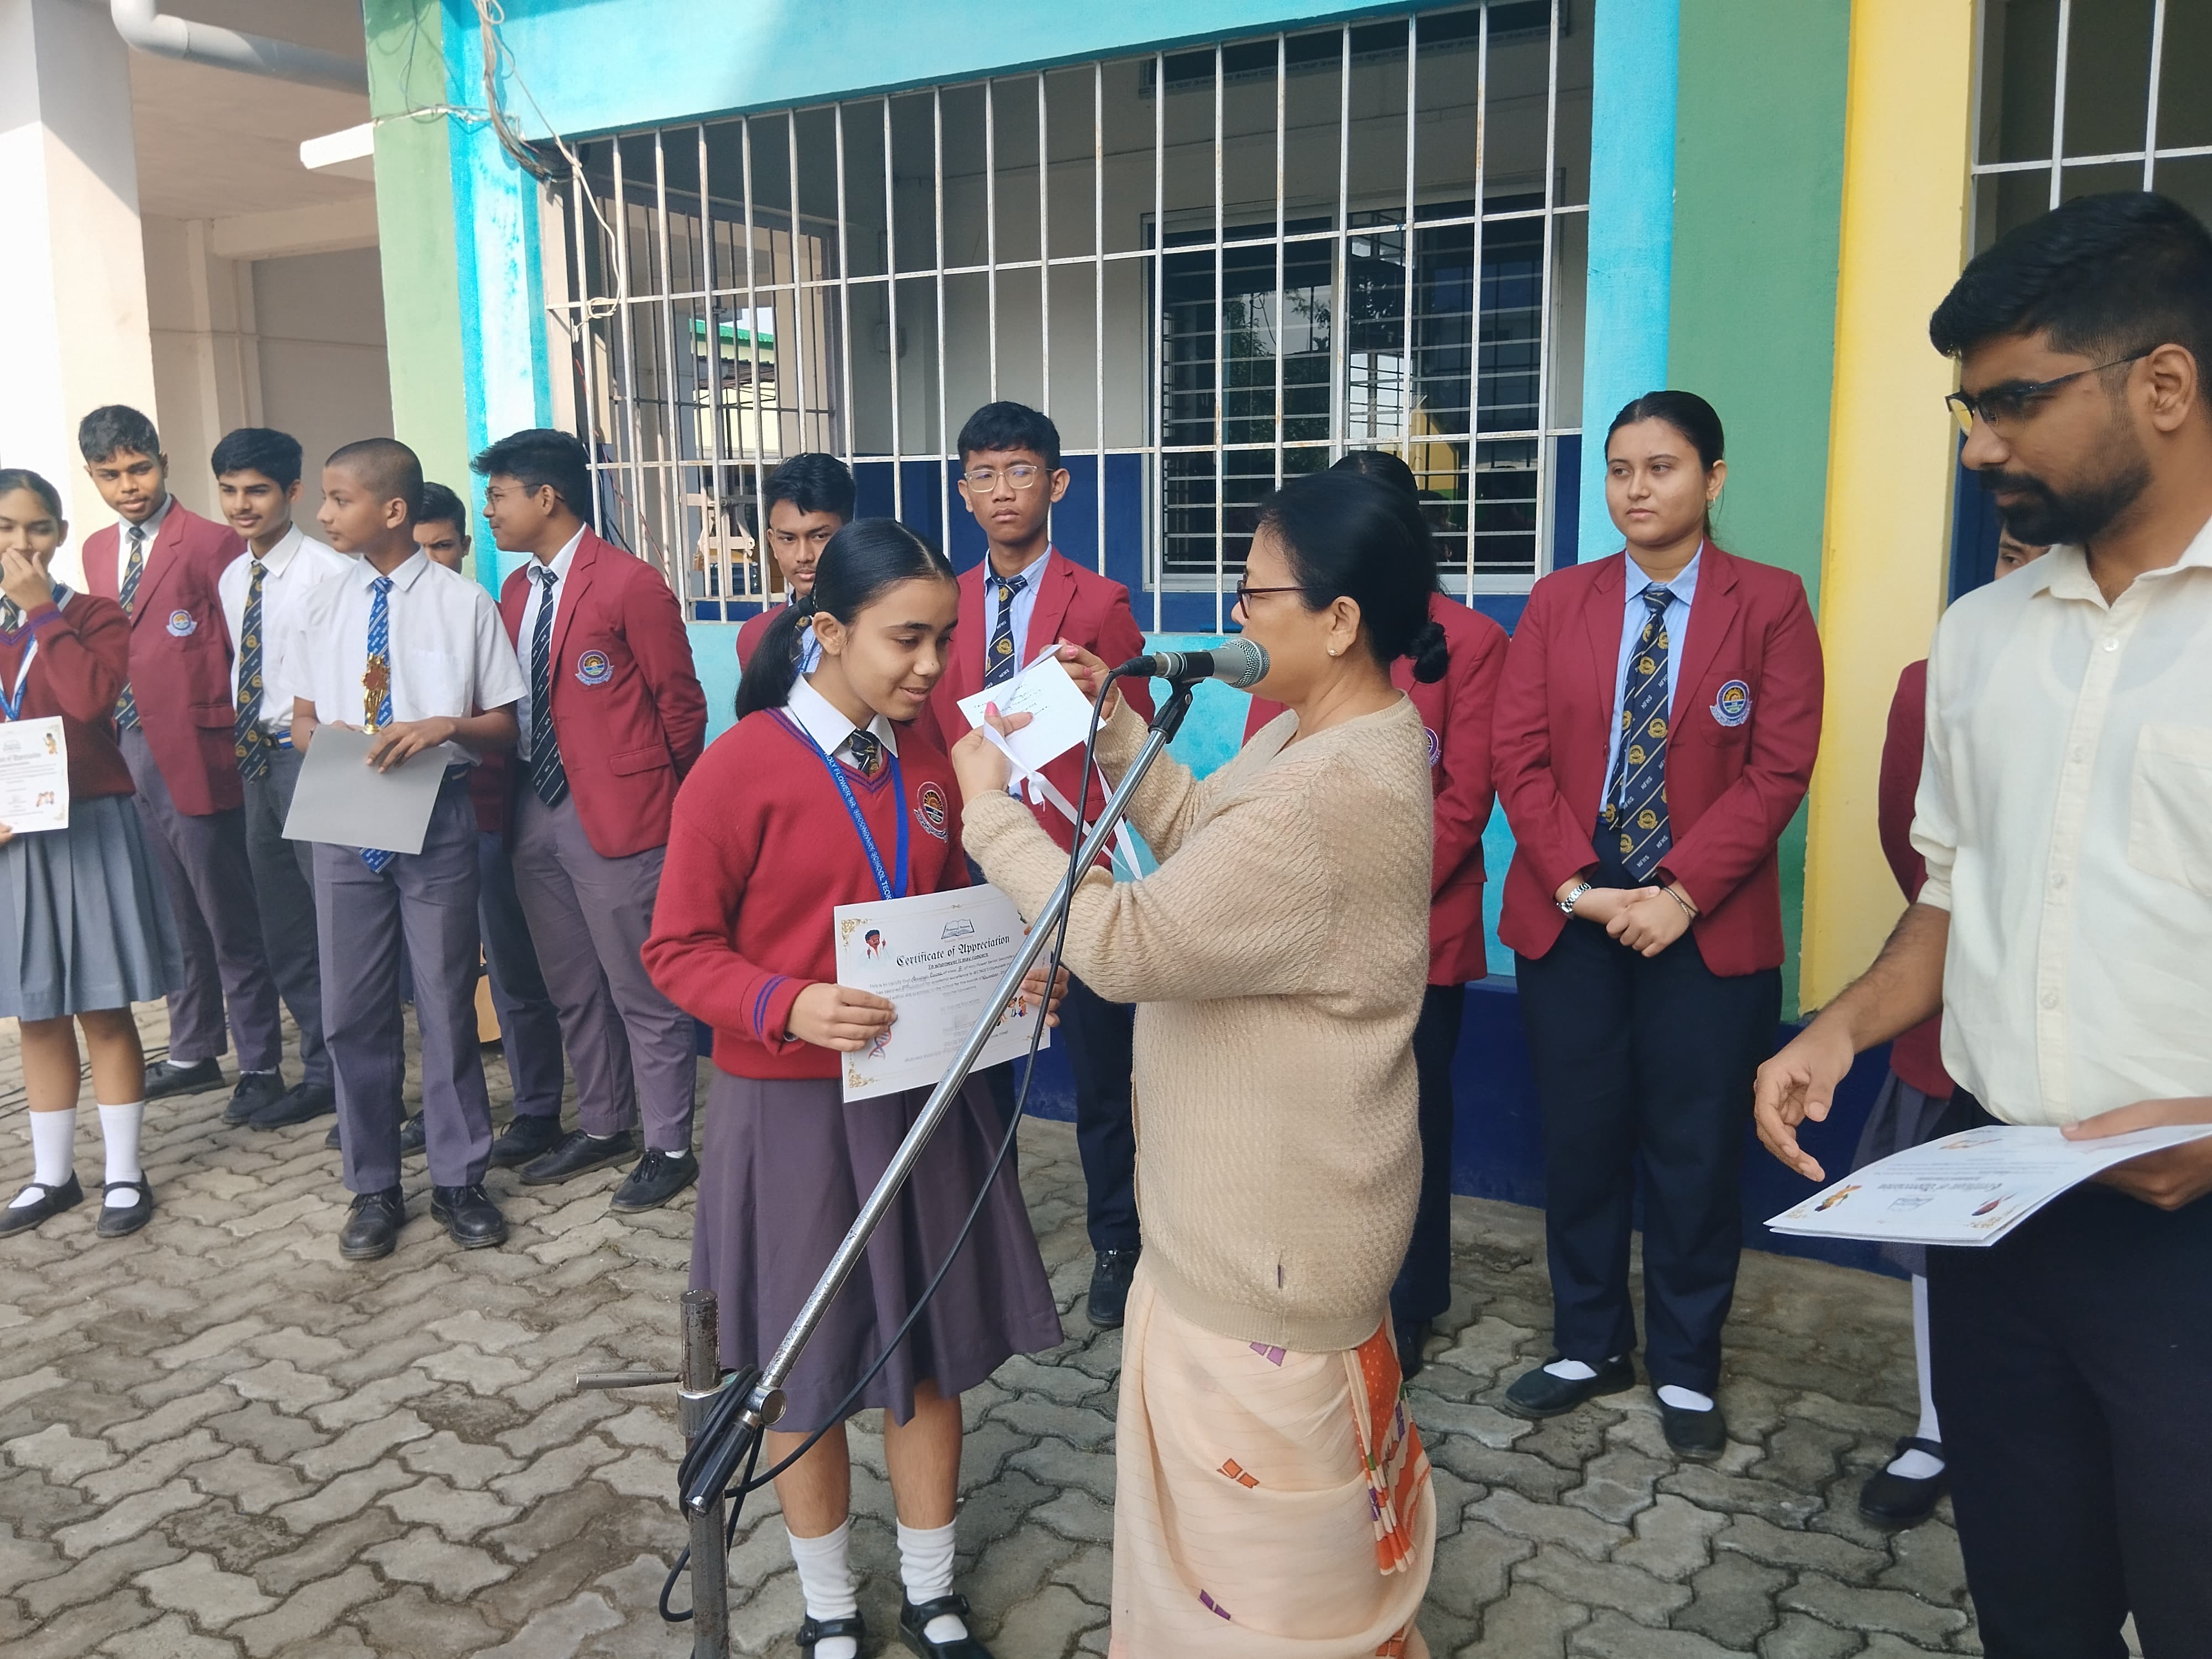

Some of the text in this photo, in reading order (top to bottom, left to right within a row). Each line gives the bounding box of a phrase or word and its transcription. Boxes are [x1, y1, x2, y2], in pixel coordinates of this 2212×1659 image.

[1641, 695, 1652, 708] HFHS
[1641, 776, 1652, 790] HFHS
[834, 768, 852, 799] FLOWER
[854, 808, 875, 852] SECONDARY
[871, 851, 885, 881] SCHOOL
[1656, 836, 1668, 848] HFHS
[1637, 855, 1649, 867] HFHS
[897, 951, 944, 967] Certificate
[948, 946, 955, 957] of
[958, 935, 1009, 954] Appreciation
